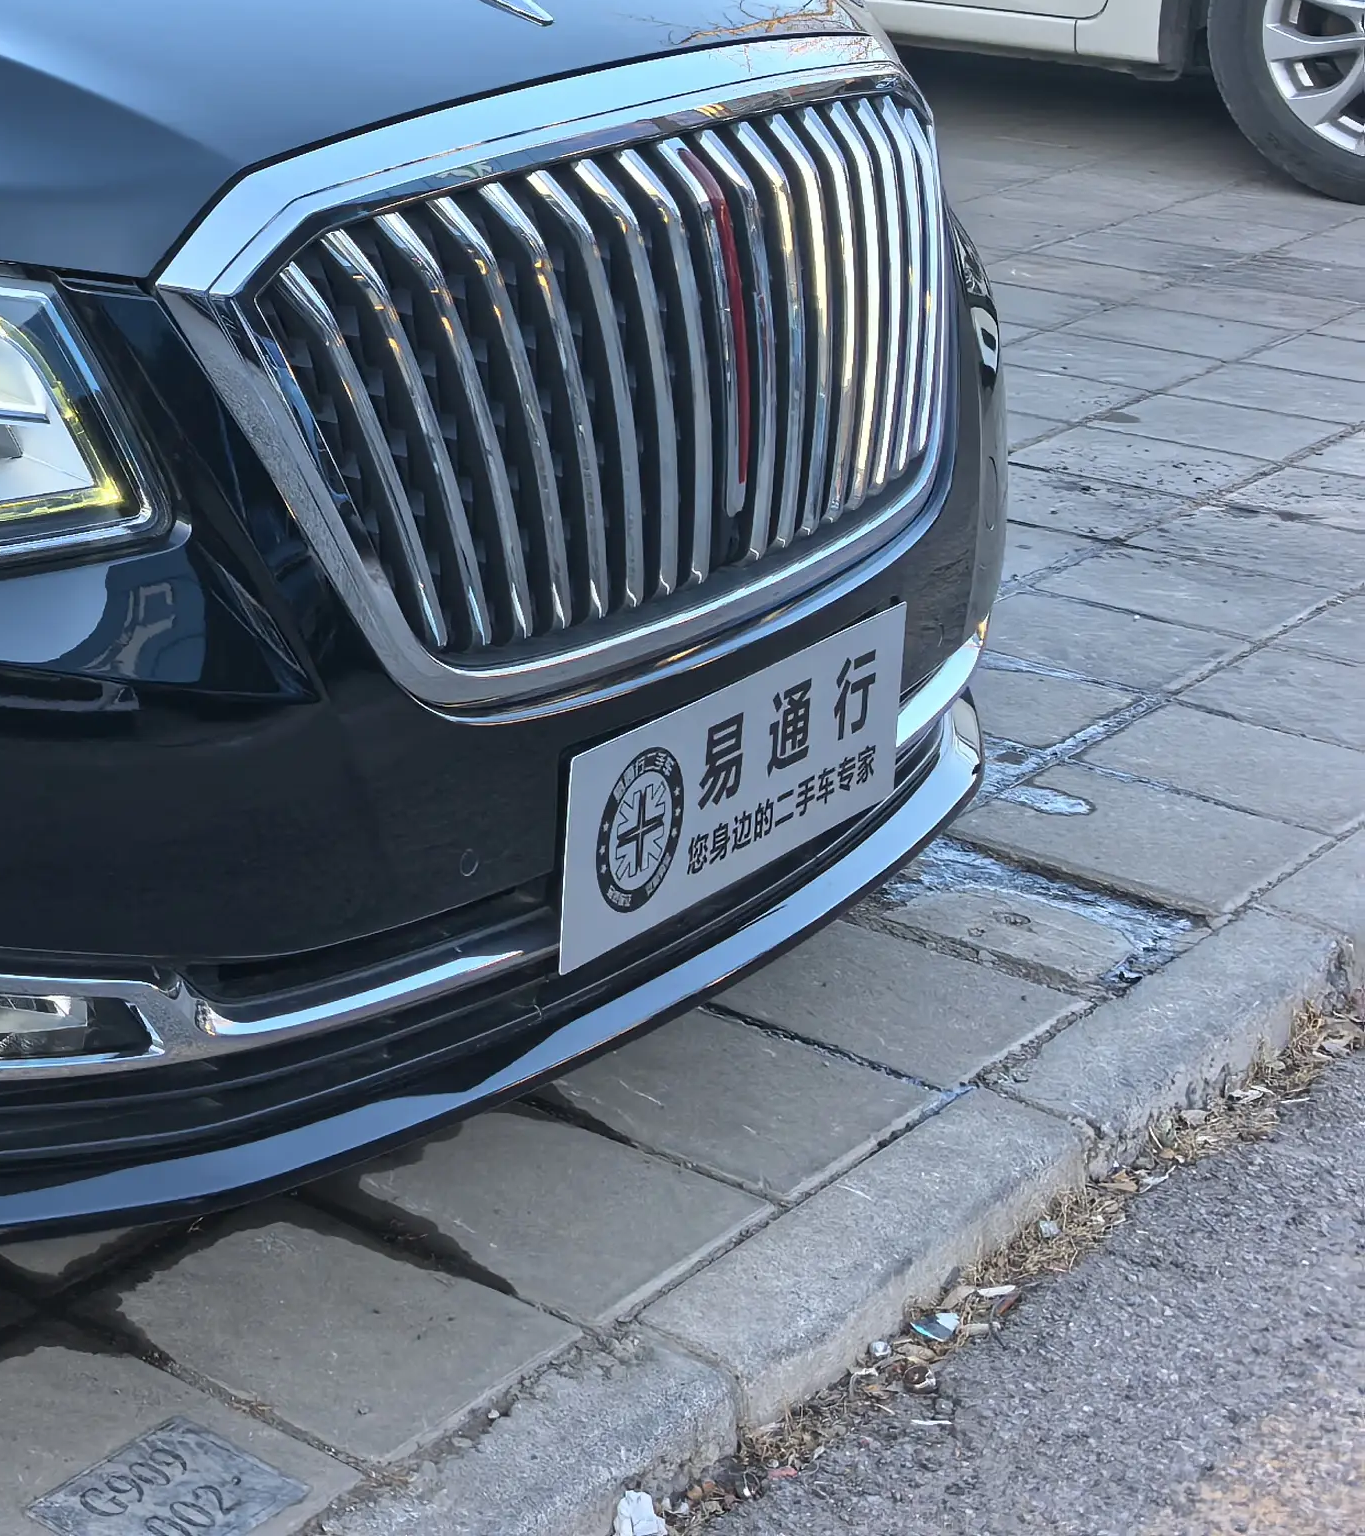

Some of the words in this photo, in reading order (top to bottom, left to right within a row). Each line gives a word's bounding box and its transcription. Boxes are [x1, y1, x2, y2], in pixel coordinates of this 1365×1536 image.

[697, 649, 877, 810] 易通行
[686, 745, 877, 876] 您身边的二手车专家
[79, 1447, 188, 1517] G909
